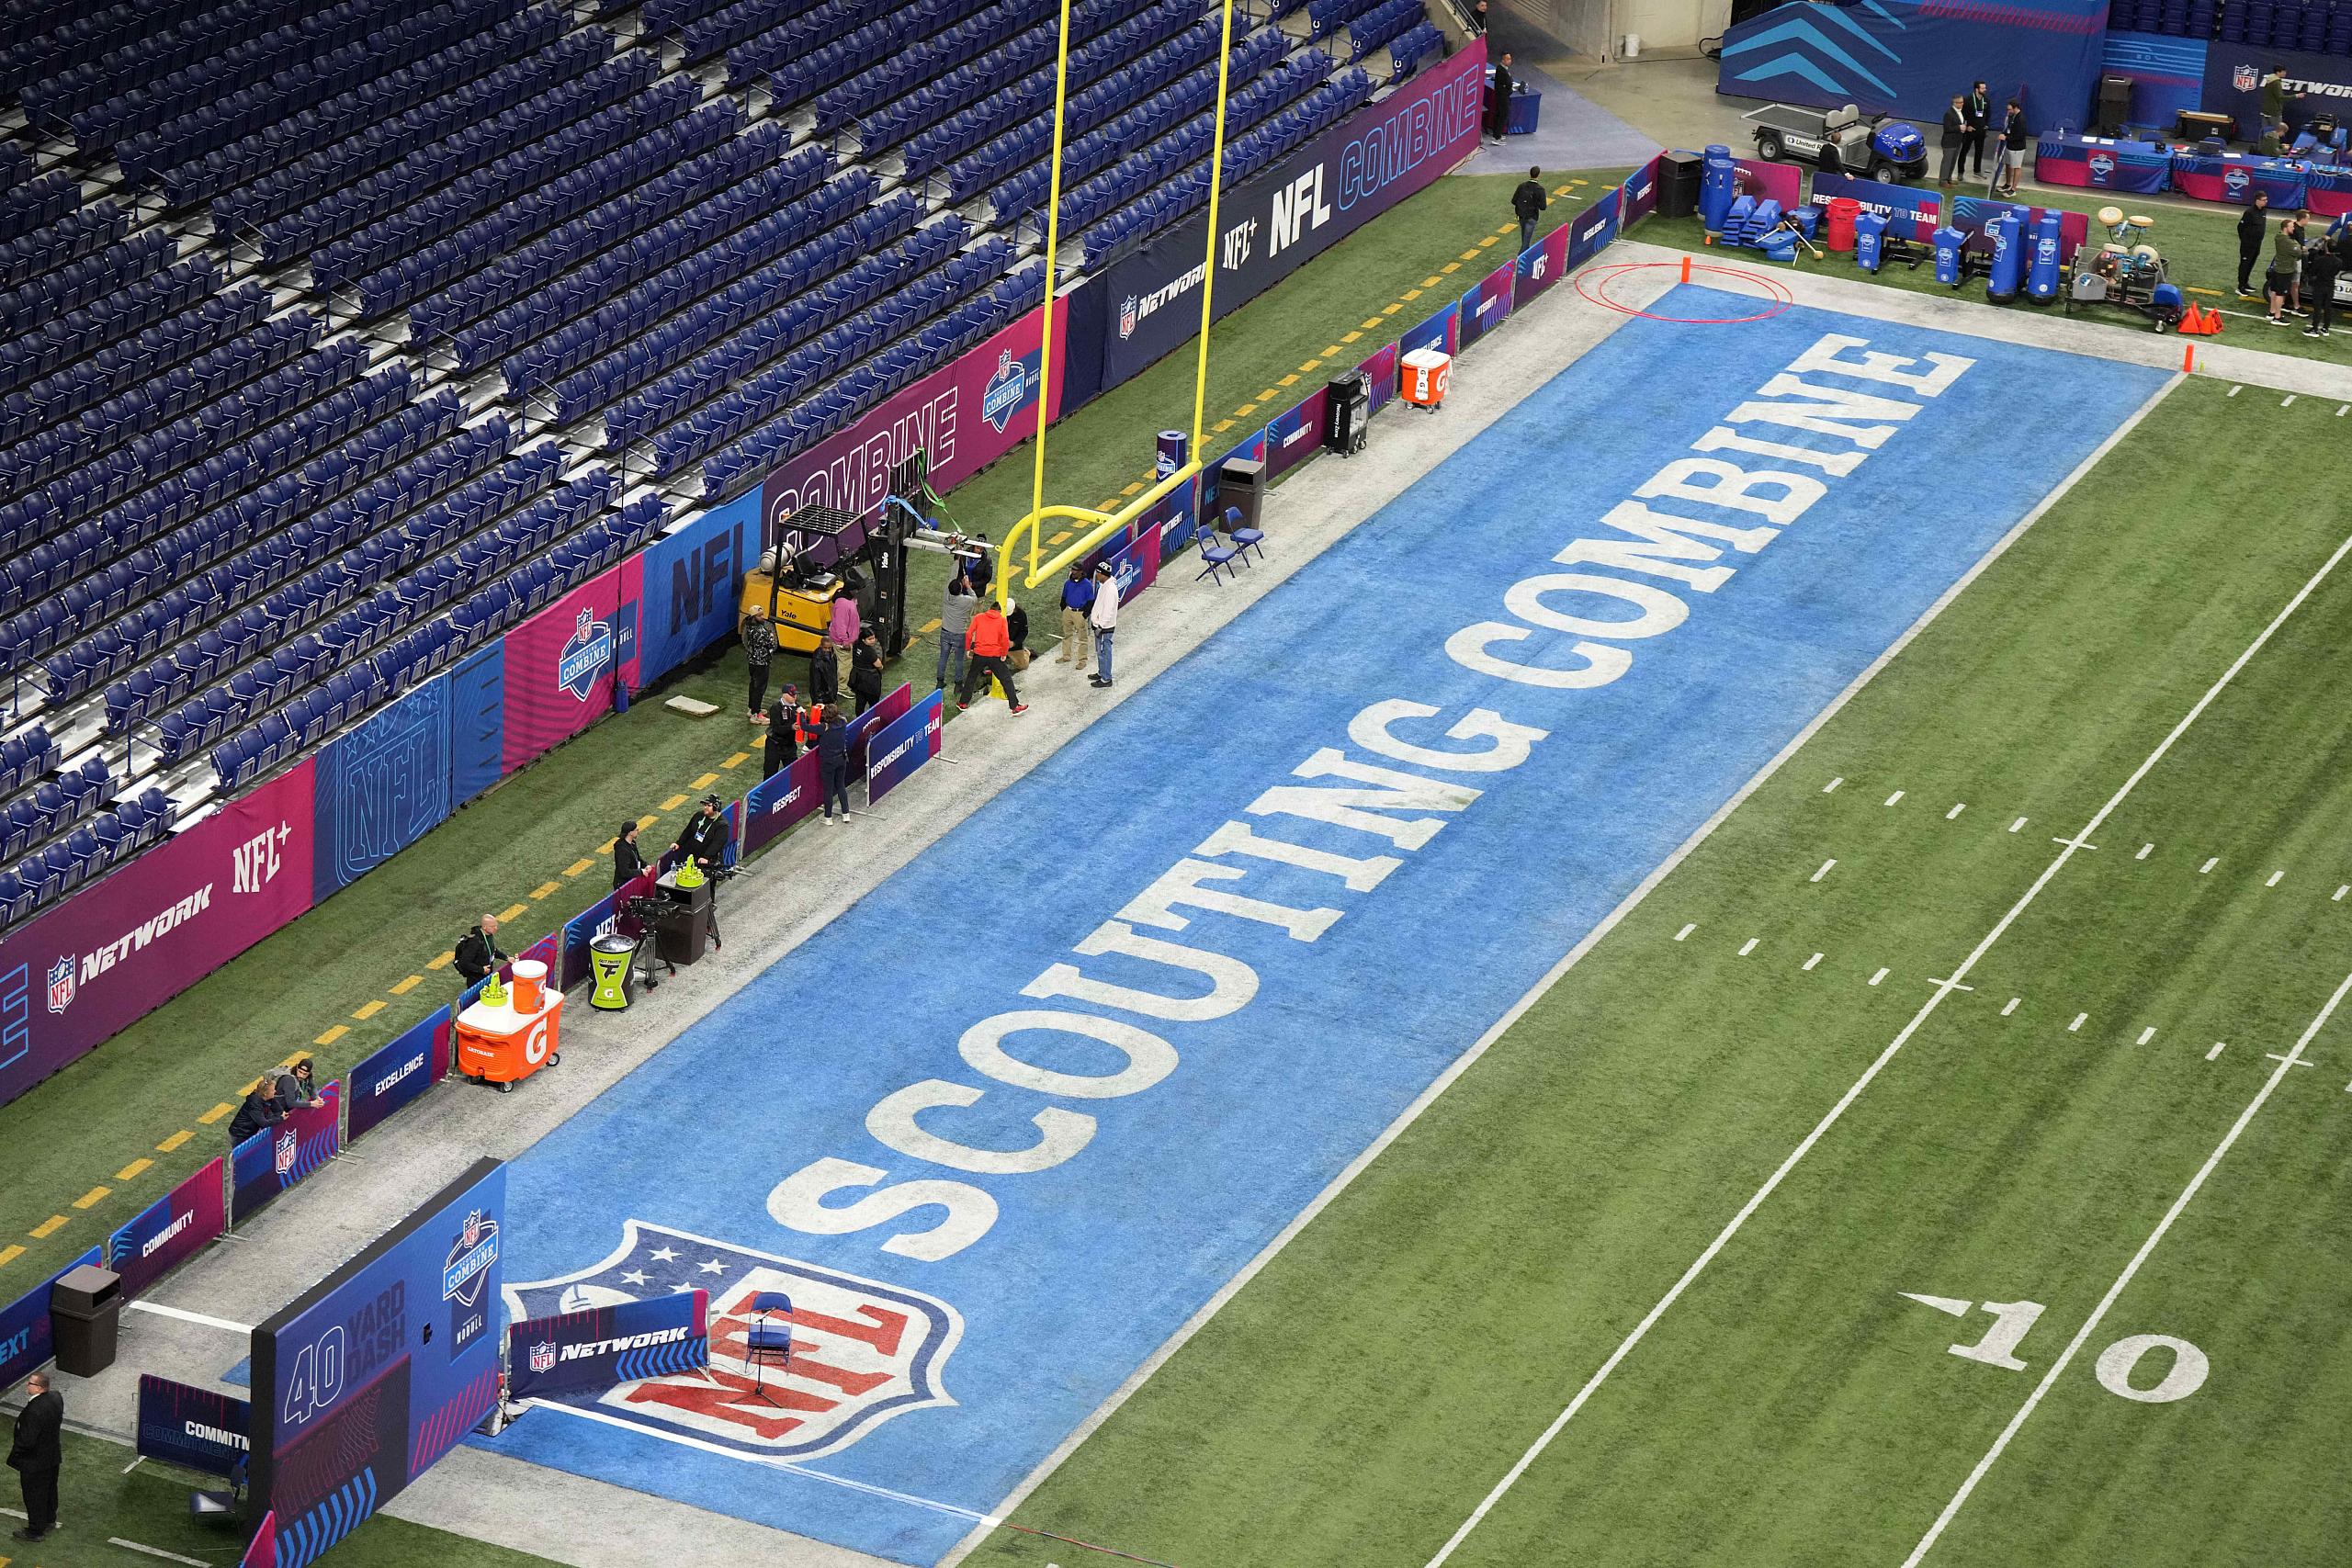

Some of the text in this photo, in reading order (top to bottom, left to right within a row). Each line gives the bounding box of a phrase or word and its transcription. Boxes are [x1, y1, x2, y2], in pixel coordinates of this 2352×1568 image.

[1338, 63, 1480, 211] COMBINE
[1268, 162, 1331, 259] NFL
[1812, 193, 1892, 214] RESBILITY
[1909, 209, 1938, 225] TEAM
[1222, 216, 1258, 270] NFL+
[1532, 253, 1549, 280] NFL+
[986, 382, 1021, 413] COMBINE
[1283, 421, 1313, 448] COMMUNITY
[1444, 333, 1977, 689] COMBINE
[881, 551, 889, 569] Yale
[781, 609, 797, 620] Yale
[612, 628, 633, 649] NBULL
[563, 644, 607, 681] COMBINE
[870, 735, 915, 780] RESPONSIBILITY
[923, 716, 940, 738] TEAM
[349, 728, 437, 862] NFL
[772, 785, 802, 815] RESPECT
[232, 819, 292, 894] NFL+
[51, 882, 213, 1008] NFL NETWORK
[604, 988, 614, 998] G
[766, 697, 1551, 1263] SCOUTING
[467, 1045, 495, 1058] GATORADE
[526, 1016, 548, 1065] G
[375, 1052, 424, 1097] EXCELLENCE
[142, 1209, 194, 1258] COMMUNITY
[447, 1244, 494, 1289] COMBINE
[459, 1245, 485, 1269] SCOUTING
[457, 1314, 482, 1345] NOBULL
[533, 1325, 689, 1368] NFL NETWORK
[1946, 1300, 2210, 1404] 10
[284, 1325, 345, 1425] 40
[186, 1420, 251, 1451] COMMITM
